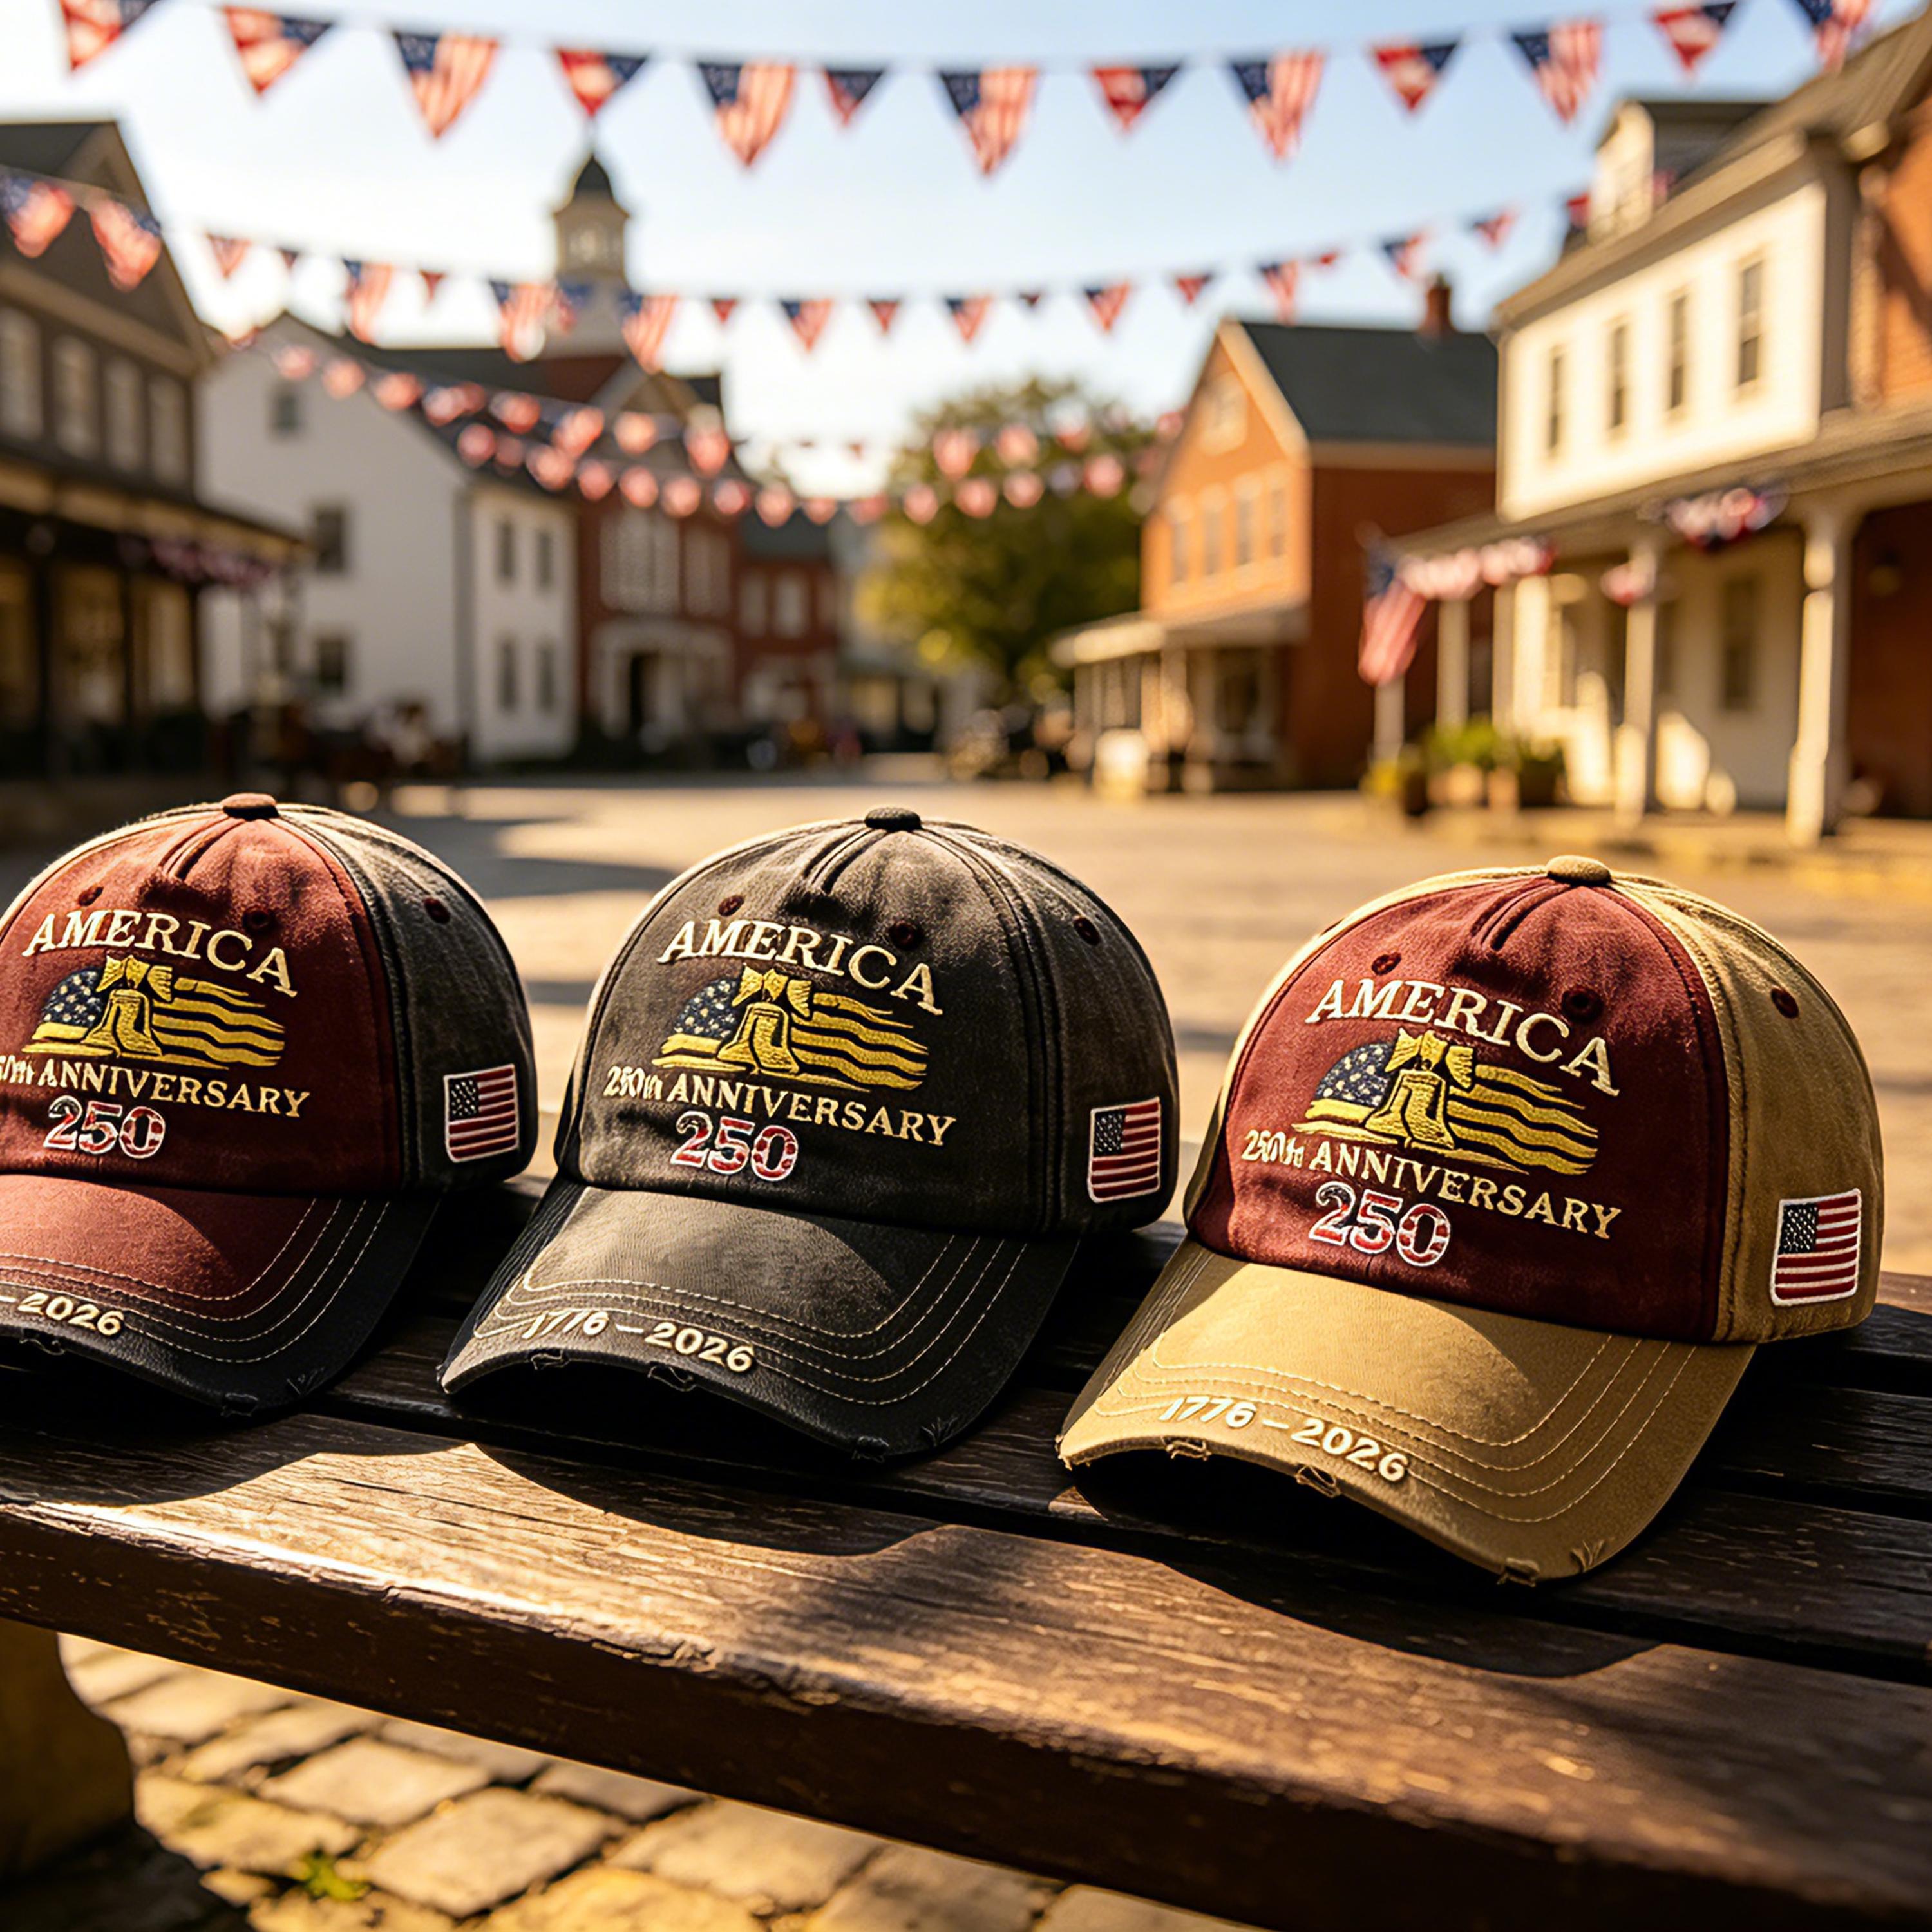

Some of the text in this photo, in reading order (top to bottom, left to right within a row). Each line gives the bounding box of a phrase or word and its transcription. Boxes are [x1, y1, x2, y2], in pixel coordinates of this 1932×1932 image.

[21, 909, 298, 998] AMERICA
[657, 918, 943, 1016] AMERICA
[1305, 978, 1620, 1097] AMERICA
[37, 1058, 310, 1117] ANNIVERSARY
[43, 1095, 166, 1159] 250
[666, 1072, 956, 1146] ANNIVERSARY
[670, 1110, 799, 1182] 250
[1308, 1180, 1451, 1267] 250
[1309, 1141, 1622, 1240] ANNIVERSARY
[17, 1293, 124, 1335] 2026
[645, 1322, 754, 1372] 2026
[1159, 1396, 1257, 1428] 1776
[1291, 1418, 1408, 1481] 2026
